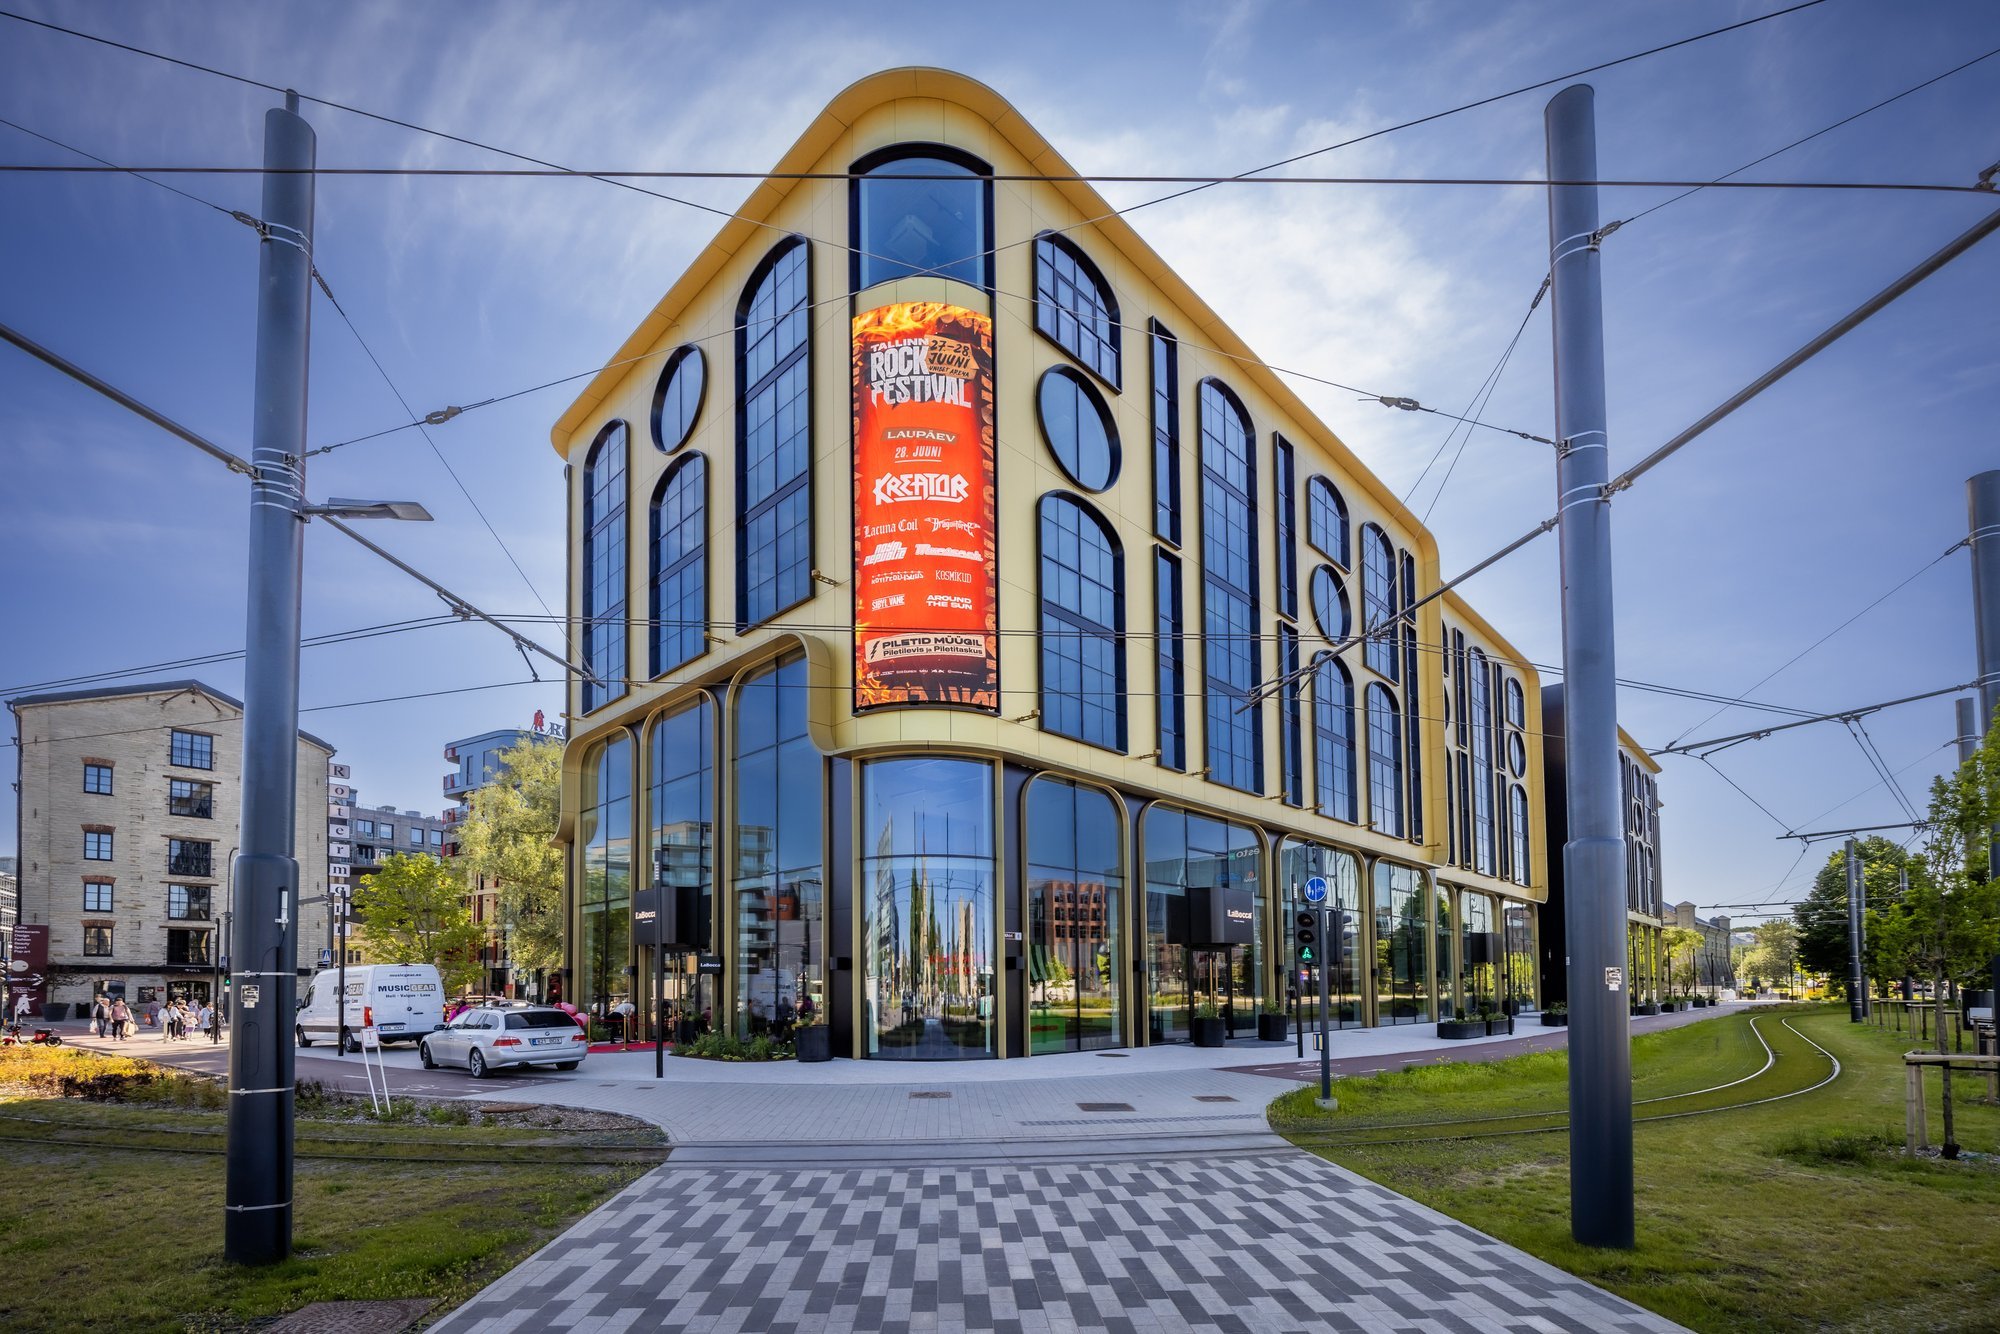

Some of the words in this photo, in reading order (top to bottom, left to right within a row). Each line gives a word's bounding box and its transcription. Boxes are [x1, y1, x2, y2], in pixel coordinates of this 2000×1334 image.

[871, 338, 929, 352] TALLINN
[870, 345, 930, 382] ROCK
[928, 352, 971, 369] JUUNI
[950, 368, 970, 378] ARENA
[870, 373, 972, 409] FESTIVAL
[887, 429, 956, 443] LAUPÄEV
[895, 447, 908, 459] 28.
[912, 446, 942, 458] JUUNI
[872, 472, 969, 506] KREATOR
[864, 522, 896, 539] Lacuna
[898, 518, 919, 533] Coil
[935, 570, 972, 584] KOSMIKUD
[871, 596, 888, 612] SIBYL
[926, 594, 972, 604] AROUND
[926, 600, 949, 608] THE
[950, 602, 973, 611] SUN
[882, 637, 932, 649] PILETID
[934, 635, 983, 647] MÜÜGIL
[883, 646, 924, 657] Piletilevis
[933, 645, 983, 655] Piletitaskus
[1227, 909, 1253, 920] LaBocca
